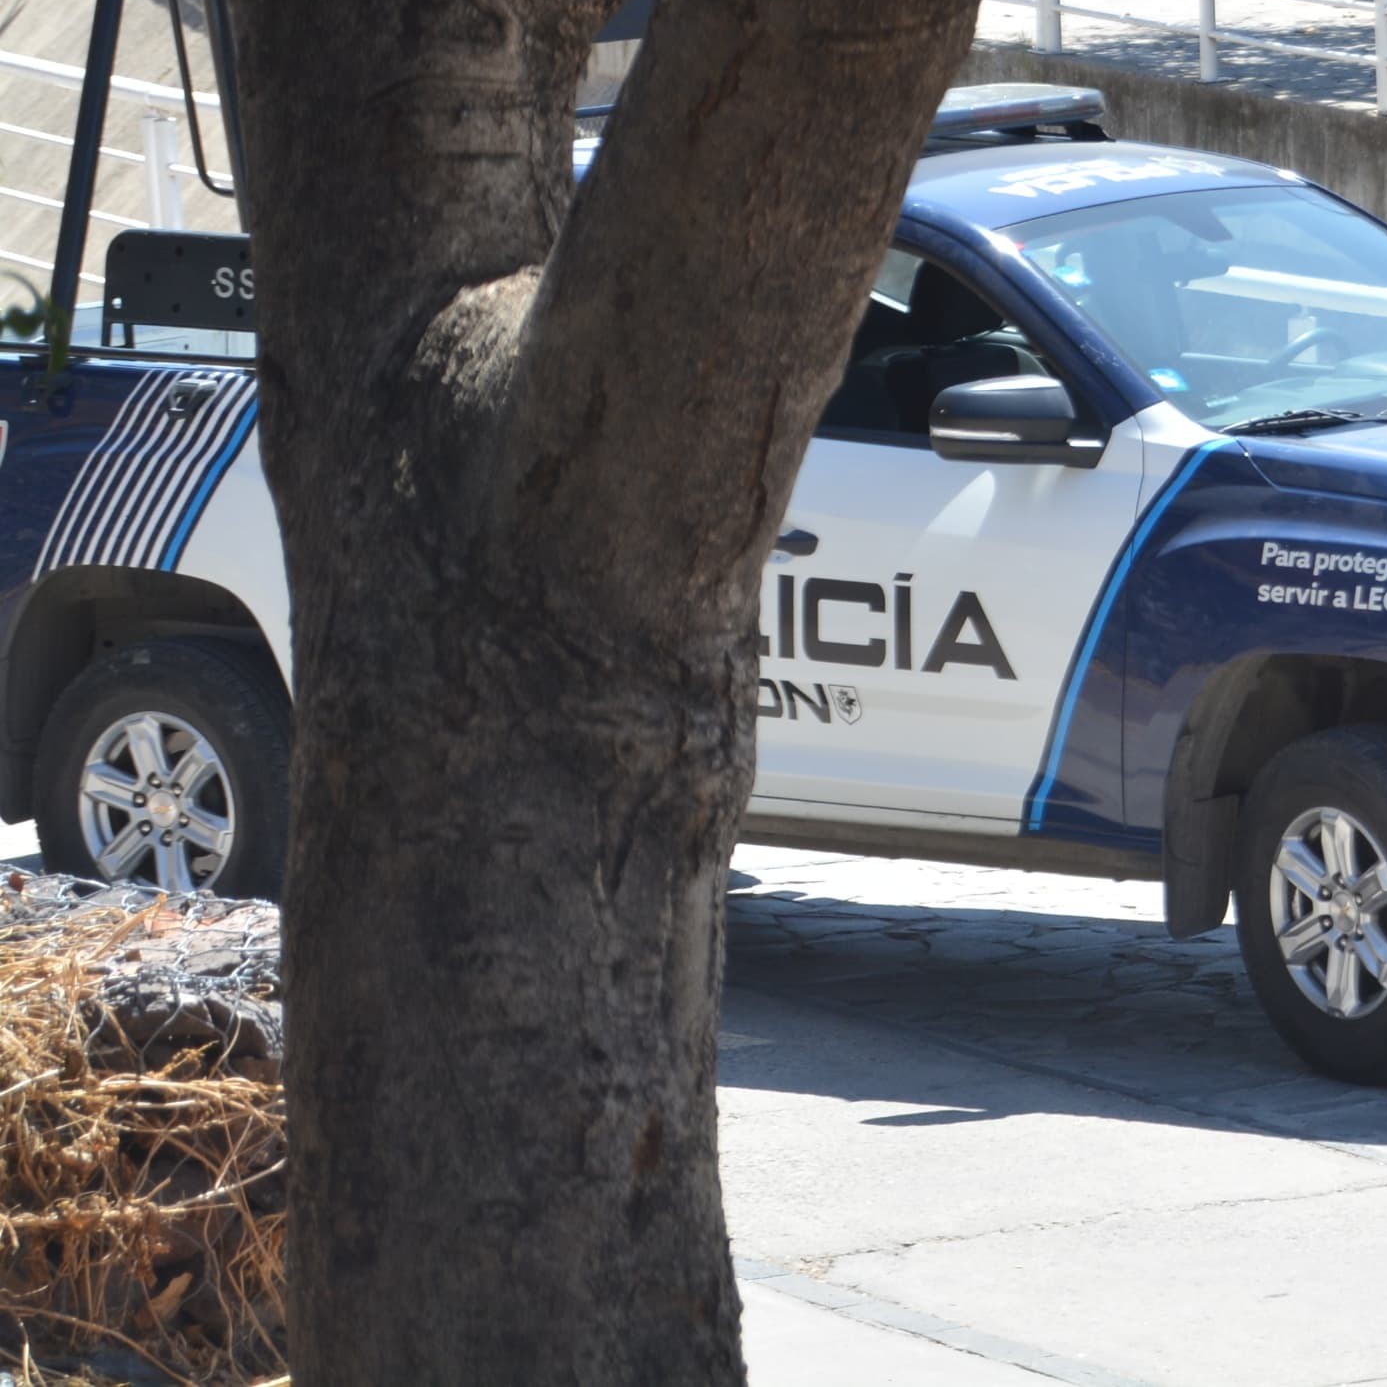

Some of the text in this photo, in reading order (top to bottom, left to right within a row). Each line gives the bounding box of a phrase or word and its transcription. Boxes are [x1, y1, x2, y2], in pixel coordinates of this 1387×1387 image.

[1261, 541, 1312, 569] Para
[1257, 581, 1330, 607] servir
[1332, 589, 1348, 609] a
[758, 571, 1019, 682] ICÍA
